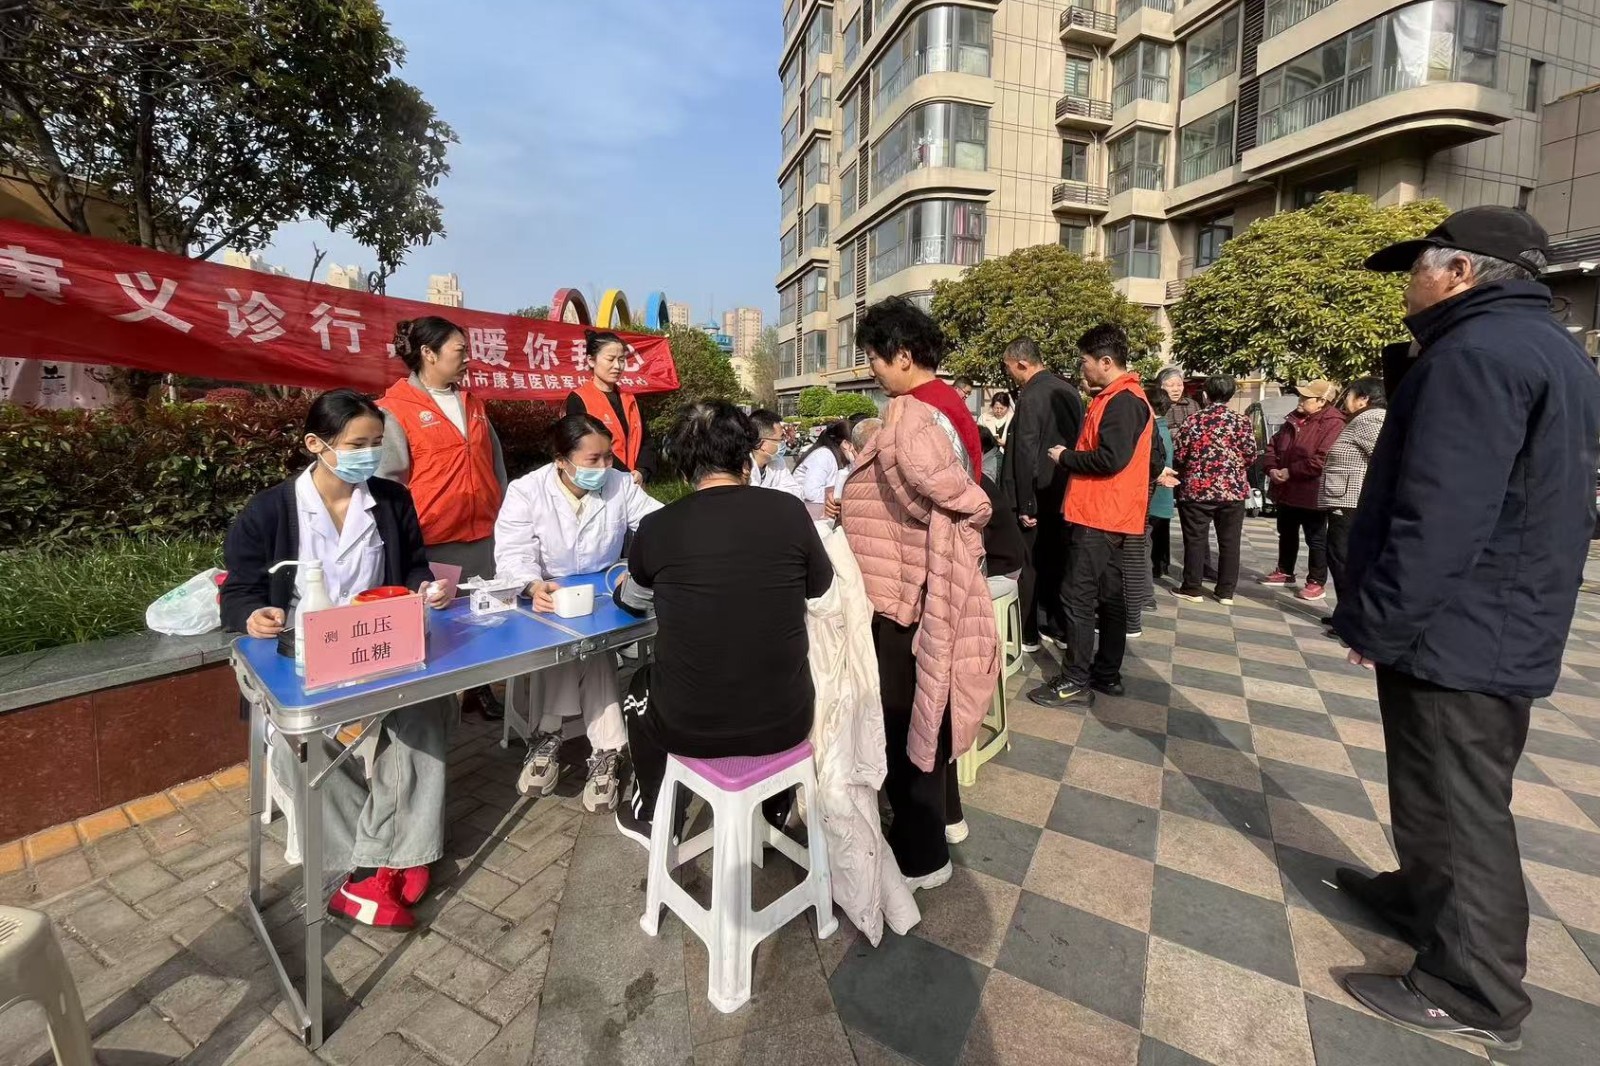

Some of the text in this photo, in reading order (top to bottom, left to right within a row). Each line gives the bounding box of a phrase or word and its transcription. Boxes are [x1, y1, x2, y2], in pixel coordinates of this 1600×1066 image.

[324, 630, 339, 643] 测
[351, 615, 392, 638] 血压
[350, 641, 391, 665] 血糖
